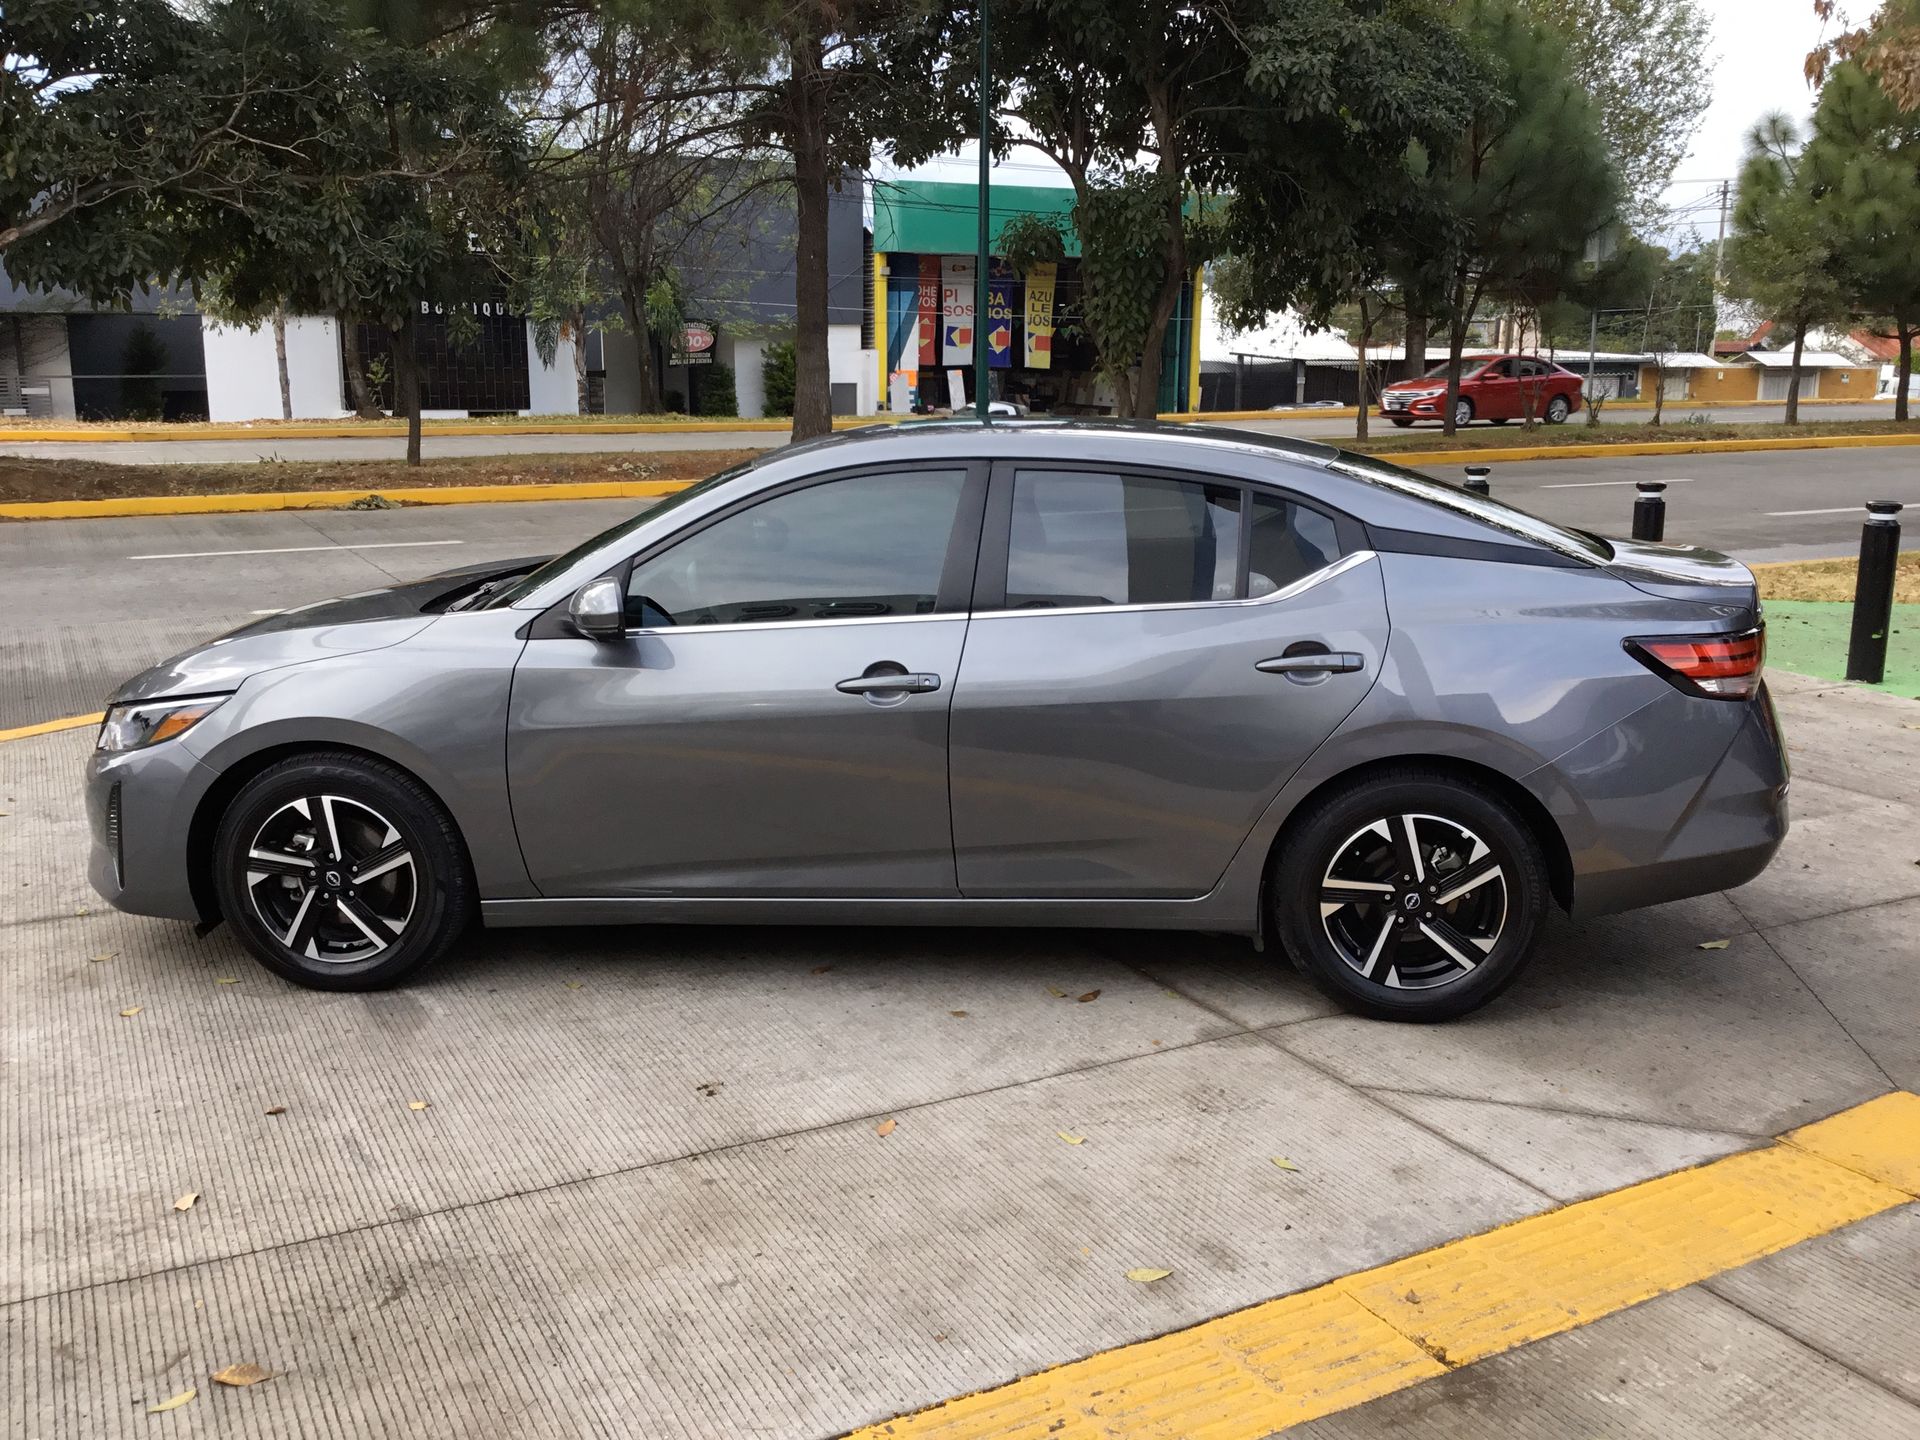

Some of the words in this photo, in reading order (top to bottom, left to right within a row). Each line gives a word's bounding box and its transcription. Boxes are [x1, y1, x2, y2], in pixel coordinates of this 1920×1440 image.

[943, 288, 958, 303] PI
[1030, 290, 1052, 303] AZU
[943, 305, 973, 317] SOS
[988, 307, 1012, 319] OS
[1031, 302, 1051, 313] LE
[1028, 314, 1050, 327] JOS
